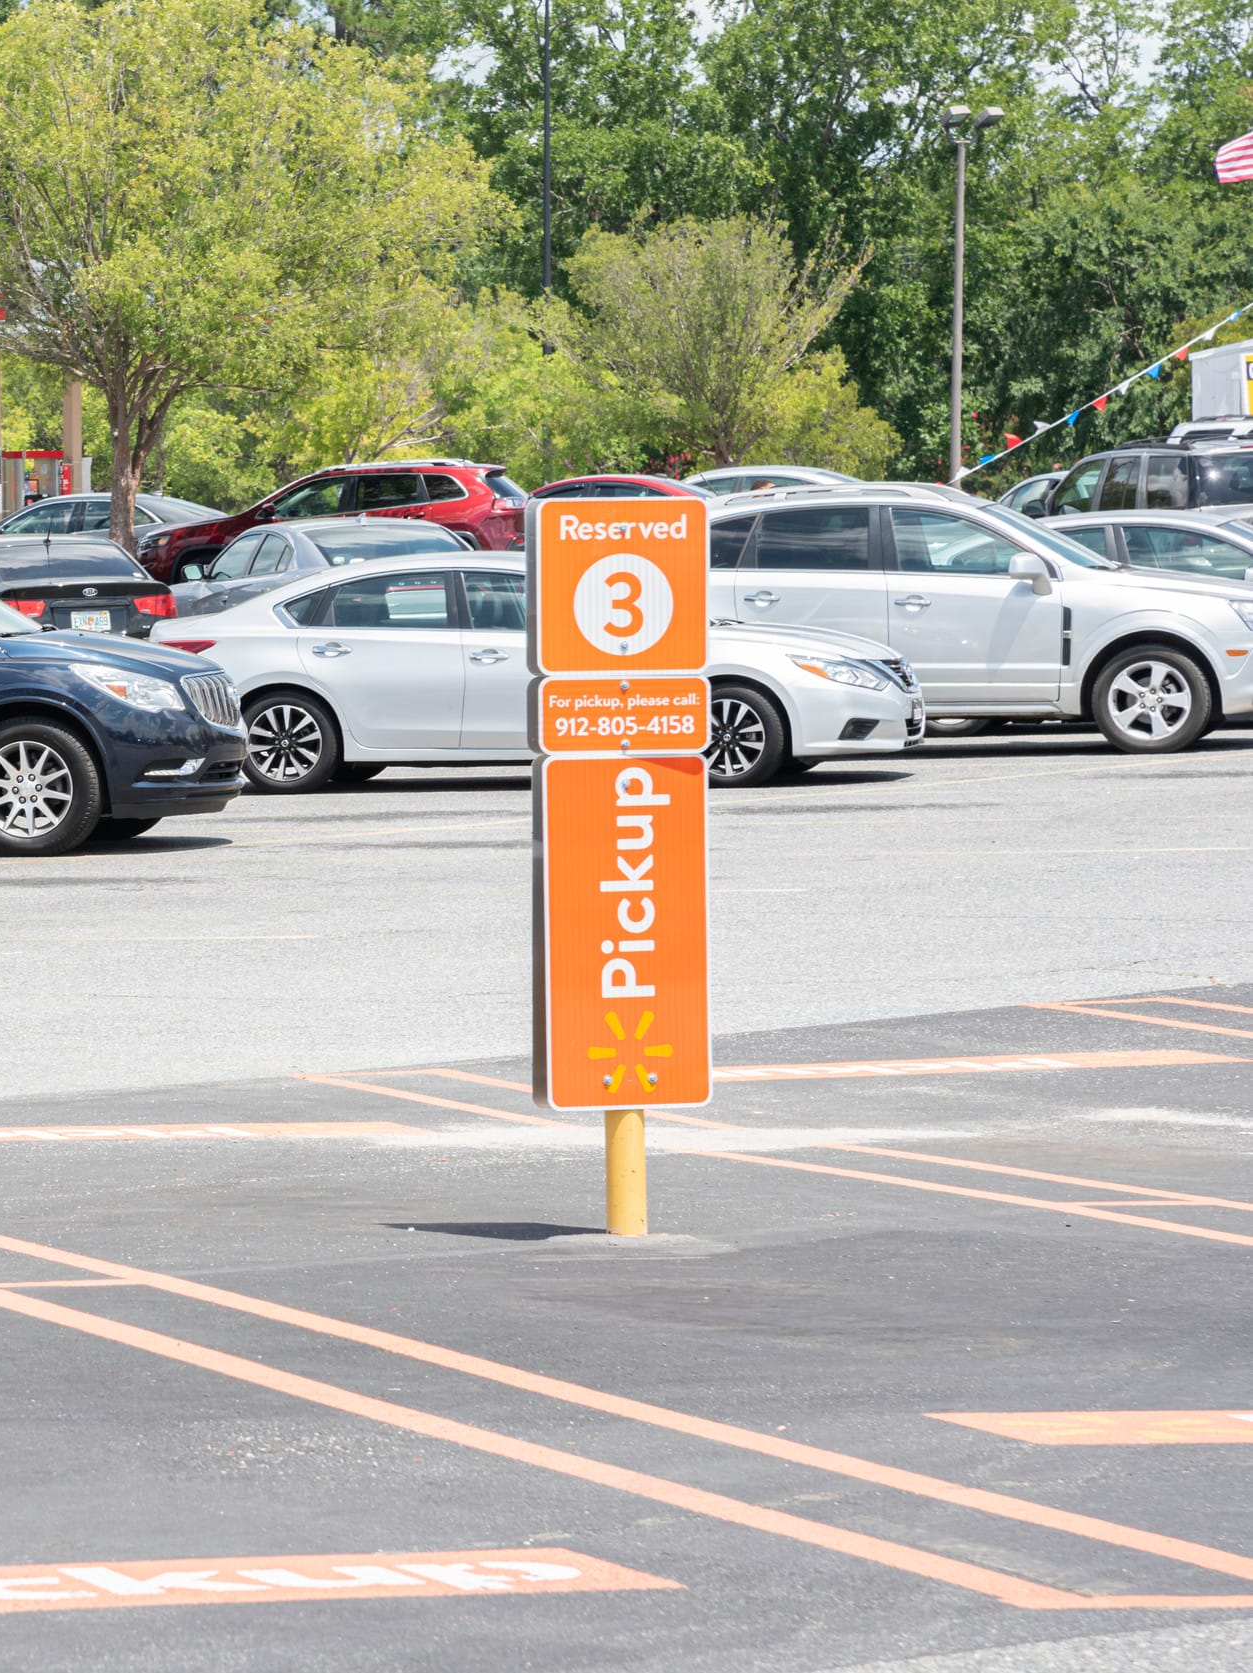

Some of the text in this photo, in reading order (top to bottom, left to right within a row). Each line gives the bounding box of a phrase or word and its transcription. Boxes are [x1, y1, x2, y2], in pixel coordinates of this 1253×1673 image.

[559, 514, 687, 541] Reserved
[603, 571, 644, 637] 3
[549, 693, 700, 711] For pickup, please call:
[555, 715, 695, 737] 912-805-4158
[600, 766, 671, 999] Pickup
